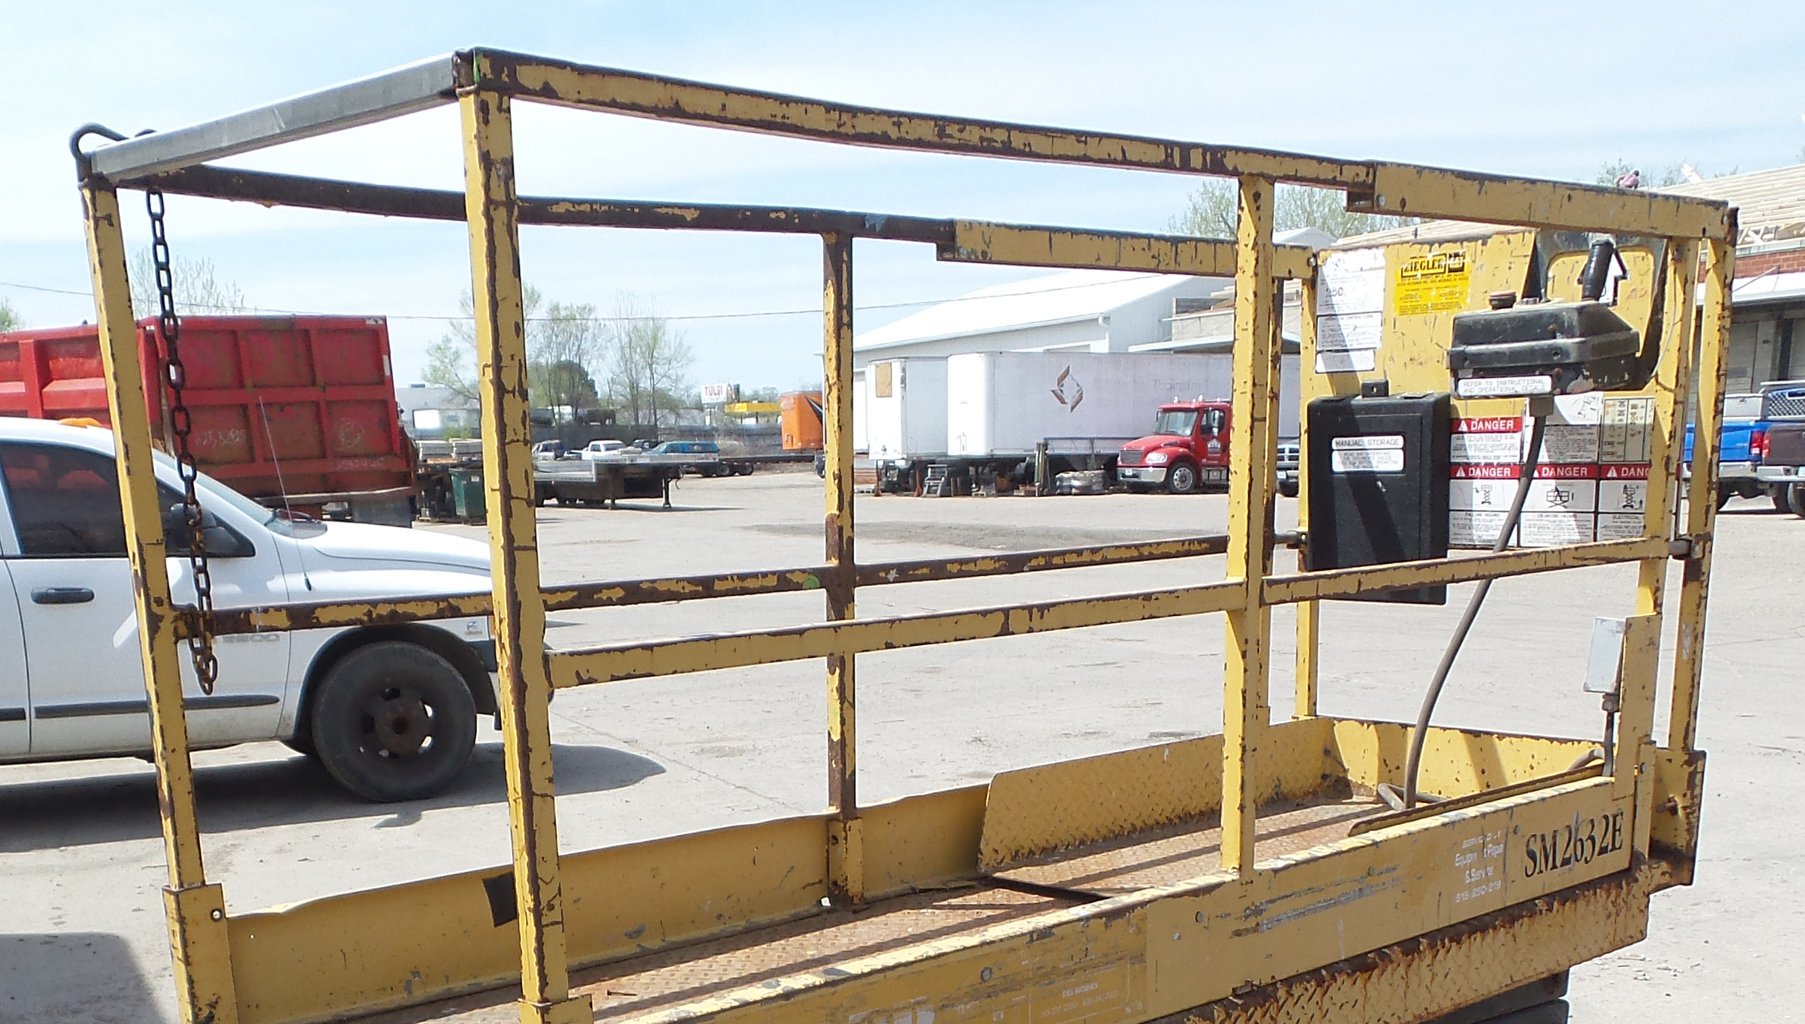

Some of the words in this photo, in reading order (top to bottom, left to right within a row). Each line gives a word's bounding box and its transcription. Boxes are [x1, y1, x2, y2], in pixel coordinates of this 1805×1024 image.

[1470, 419, 1514, 431] DANGER
[1335, 439, 1364, 448] MANUAL
[1367, 438, 1400, 447] STORAGE
[1468, 466, 1511, 477] DANGER
[1541, 466, 1588, 477] DANGER
[1524, 811, 1624, 878] SM2632E
